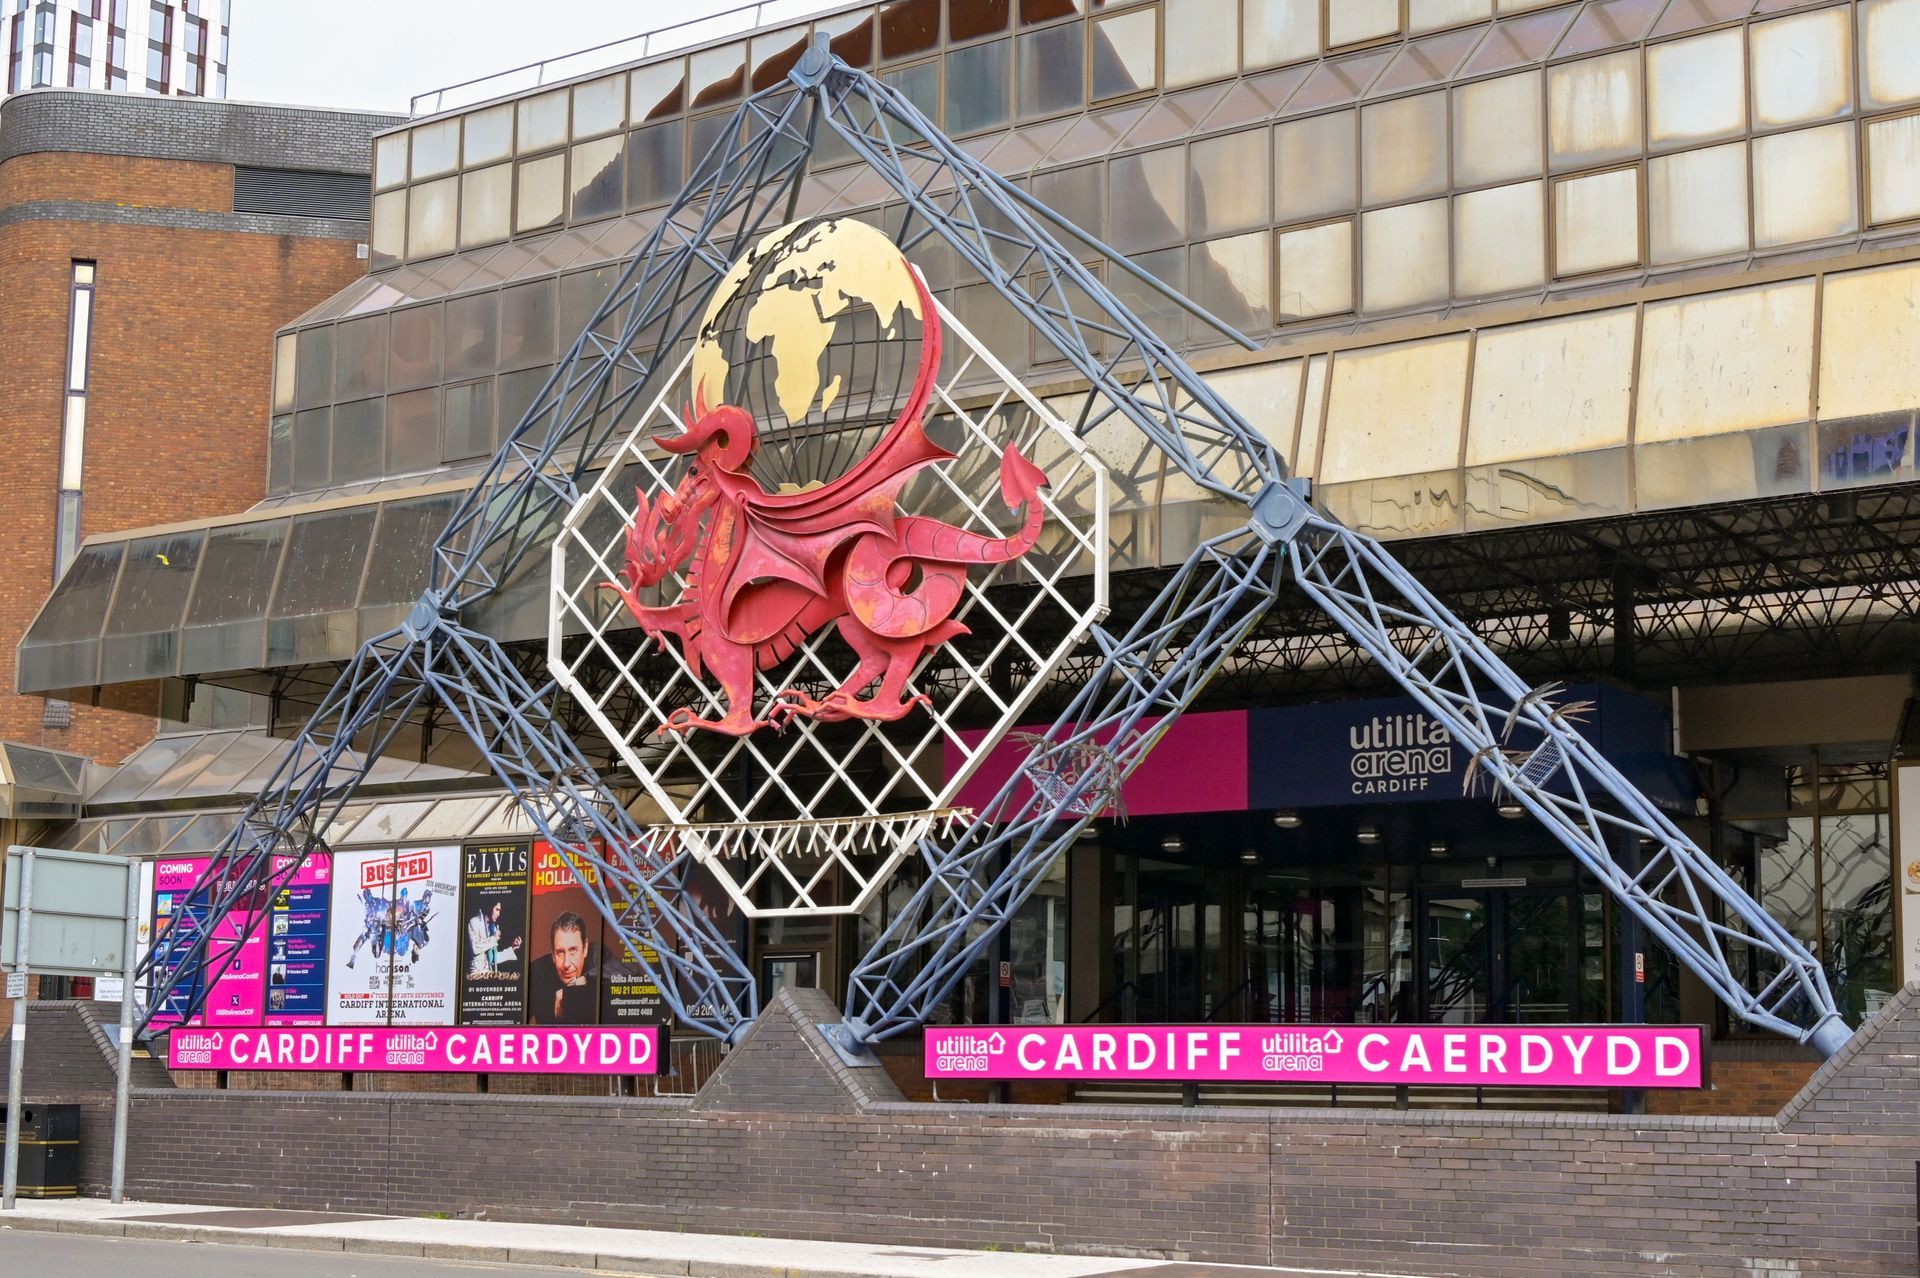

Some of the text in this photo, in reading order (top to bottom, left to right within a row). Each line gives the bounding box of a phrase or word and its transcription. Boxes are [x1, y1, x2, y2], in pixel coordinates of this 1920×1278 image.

[1350, 713, 1450, 750] utilita
[1350, 747, 1452, 778] arena
[1351, 777, 1429, 795] CARDIFF
[160, 863, 193, 875] COMING
[366, 857, 428, 882] BUSTED
[467, 851, 527, 874] ELVIS
[159, 875, 182, 885] SOON
[627, 974, 643, 983] Arena
[610, 986, 622, 995] THU
[622, 986, 630, 994] 21
[339, 1000, 375, 1009] CARDIFF
[617, 1008, 627, 1016] 029
[627, 1008, 640, 1016] 2022
[177, 1032, 651, 1065] utilita CARDIFF utilita CAERDYDD
[177, 1050, 424, 1065] arena arena
[936, 1032, 1691, 1077] utilita CARDIFF utilita CAERDYDD
[936, 1054, 1322, 1072] arena arena
